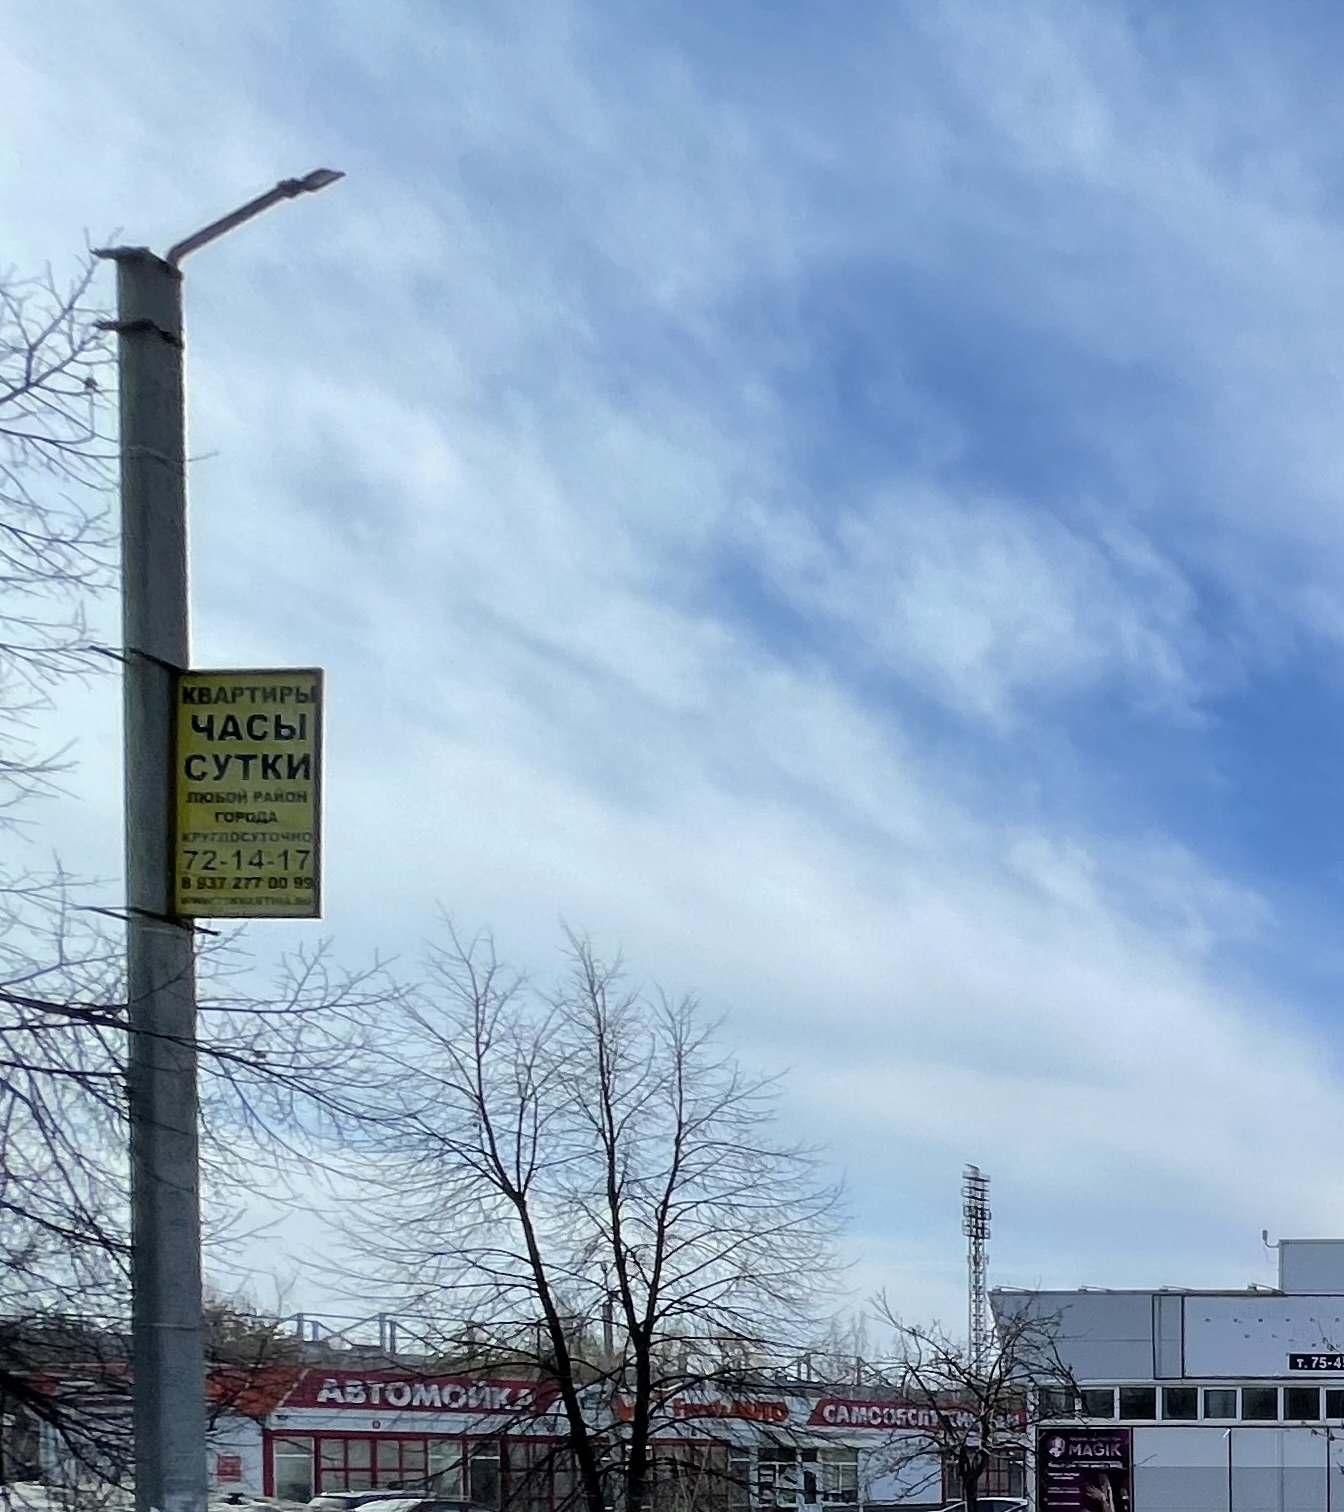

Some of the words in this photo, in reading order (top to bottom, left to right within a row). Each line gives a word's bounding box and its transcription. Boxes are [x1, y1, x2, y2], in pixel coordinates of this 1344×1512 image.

[182, 686, 316, 704] КВАРТИРЫ
[191, 714, 306, 741] ЧАСЫ
[184, 753, 311, 781] СУТКИ
[253, 789, 307, 803] РАЙОН
[214, 811, 278, 824] ГОРОДА
[183, 849, 310, 870] 72-14-17
[316, 1378, 537, 1411] АВТОМОЙКА
